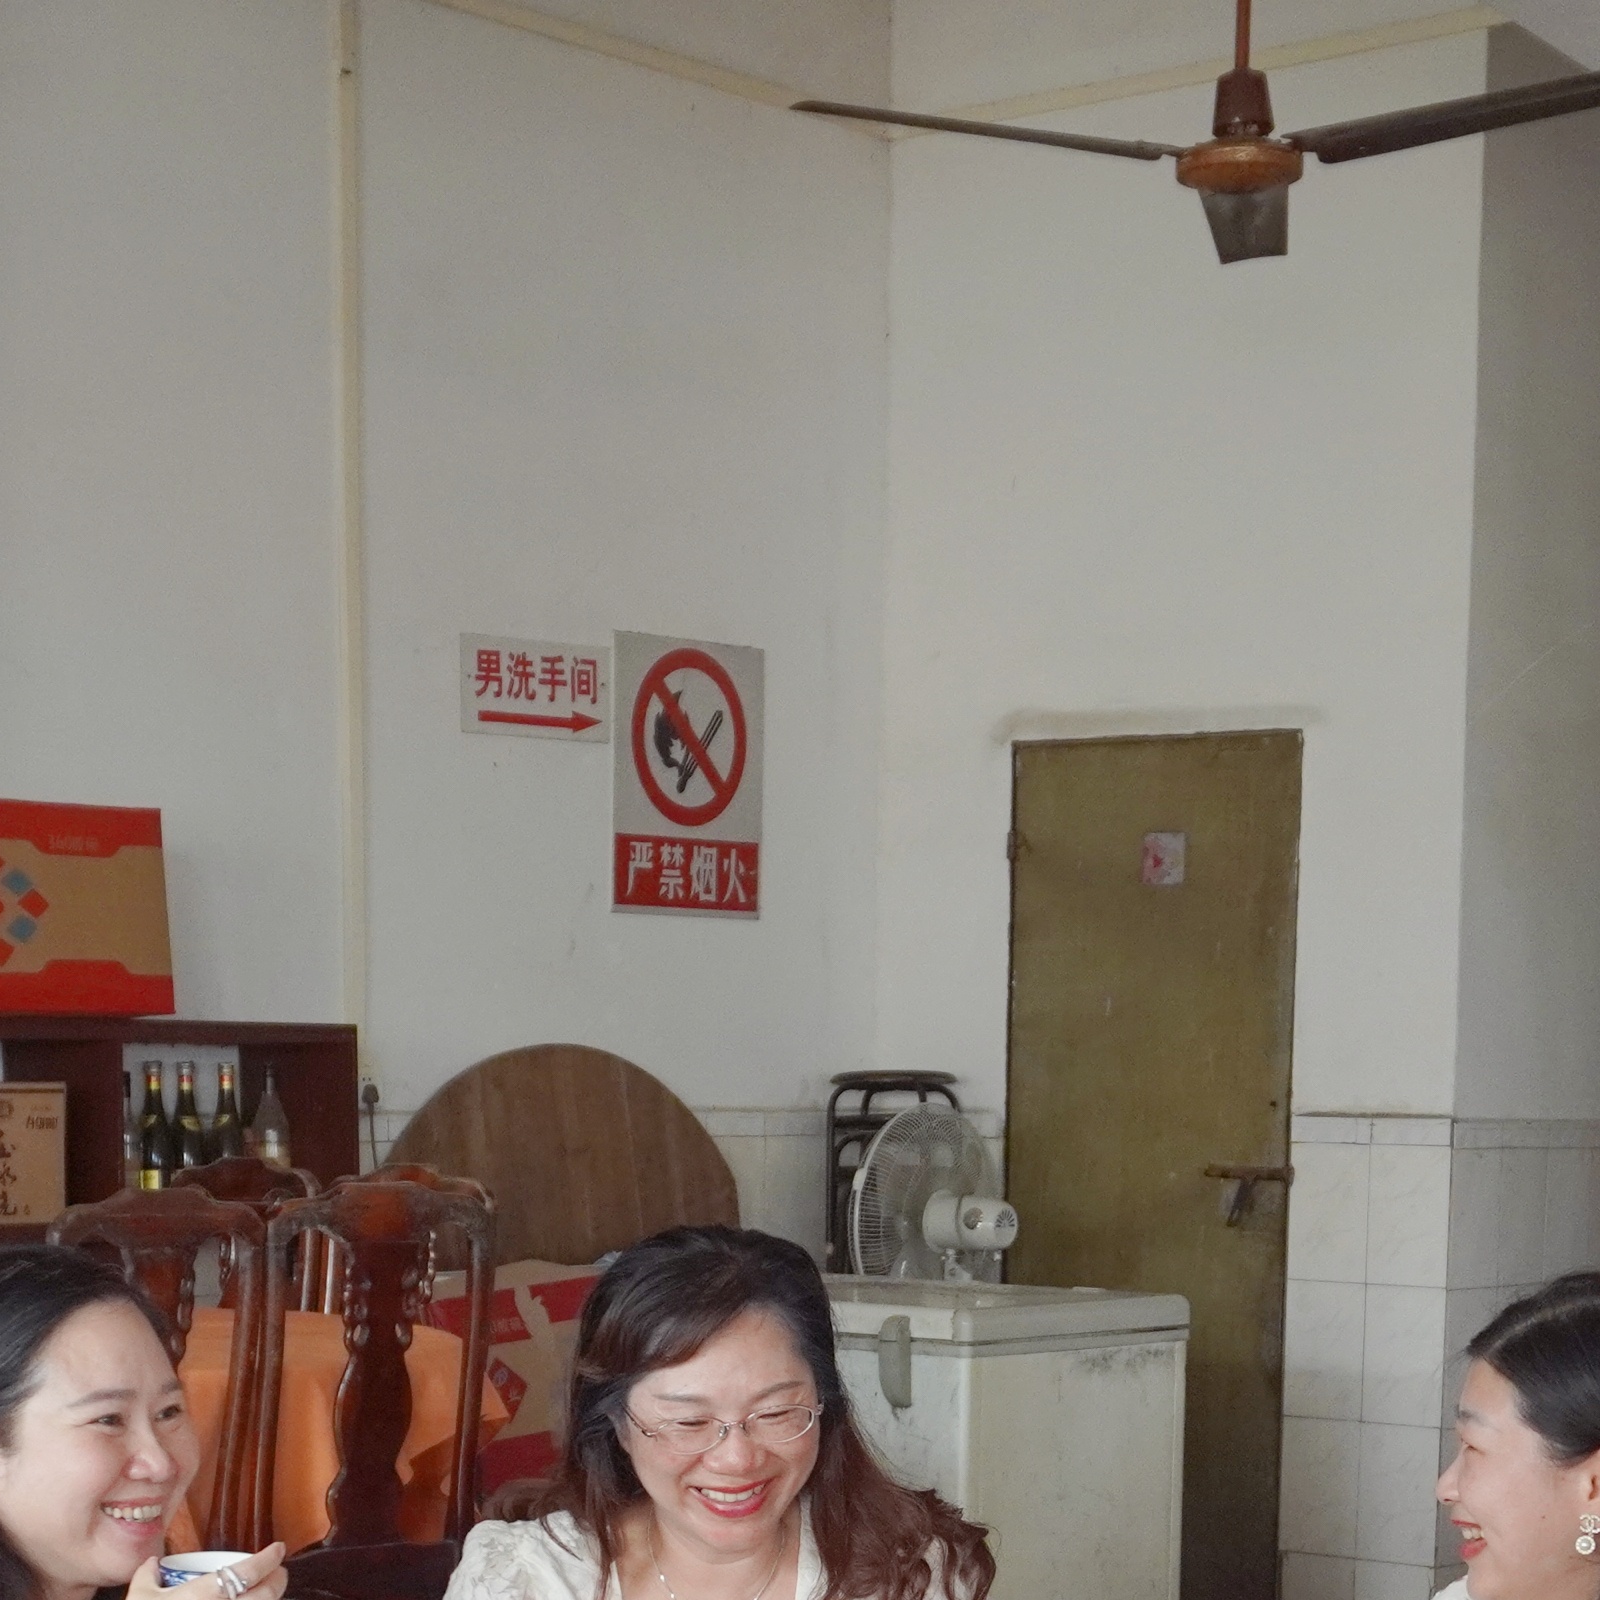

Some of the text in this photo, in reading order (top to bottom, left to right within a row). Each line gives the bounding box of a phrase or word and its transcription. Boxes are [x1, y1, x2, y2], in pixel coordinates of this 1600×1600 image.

[474, 648, 599, 705] 男洗手间
[626, 840, 748, 904] 严禁烟火
